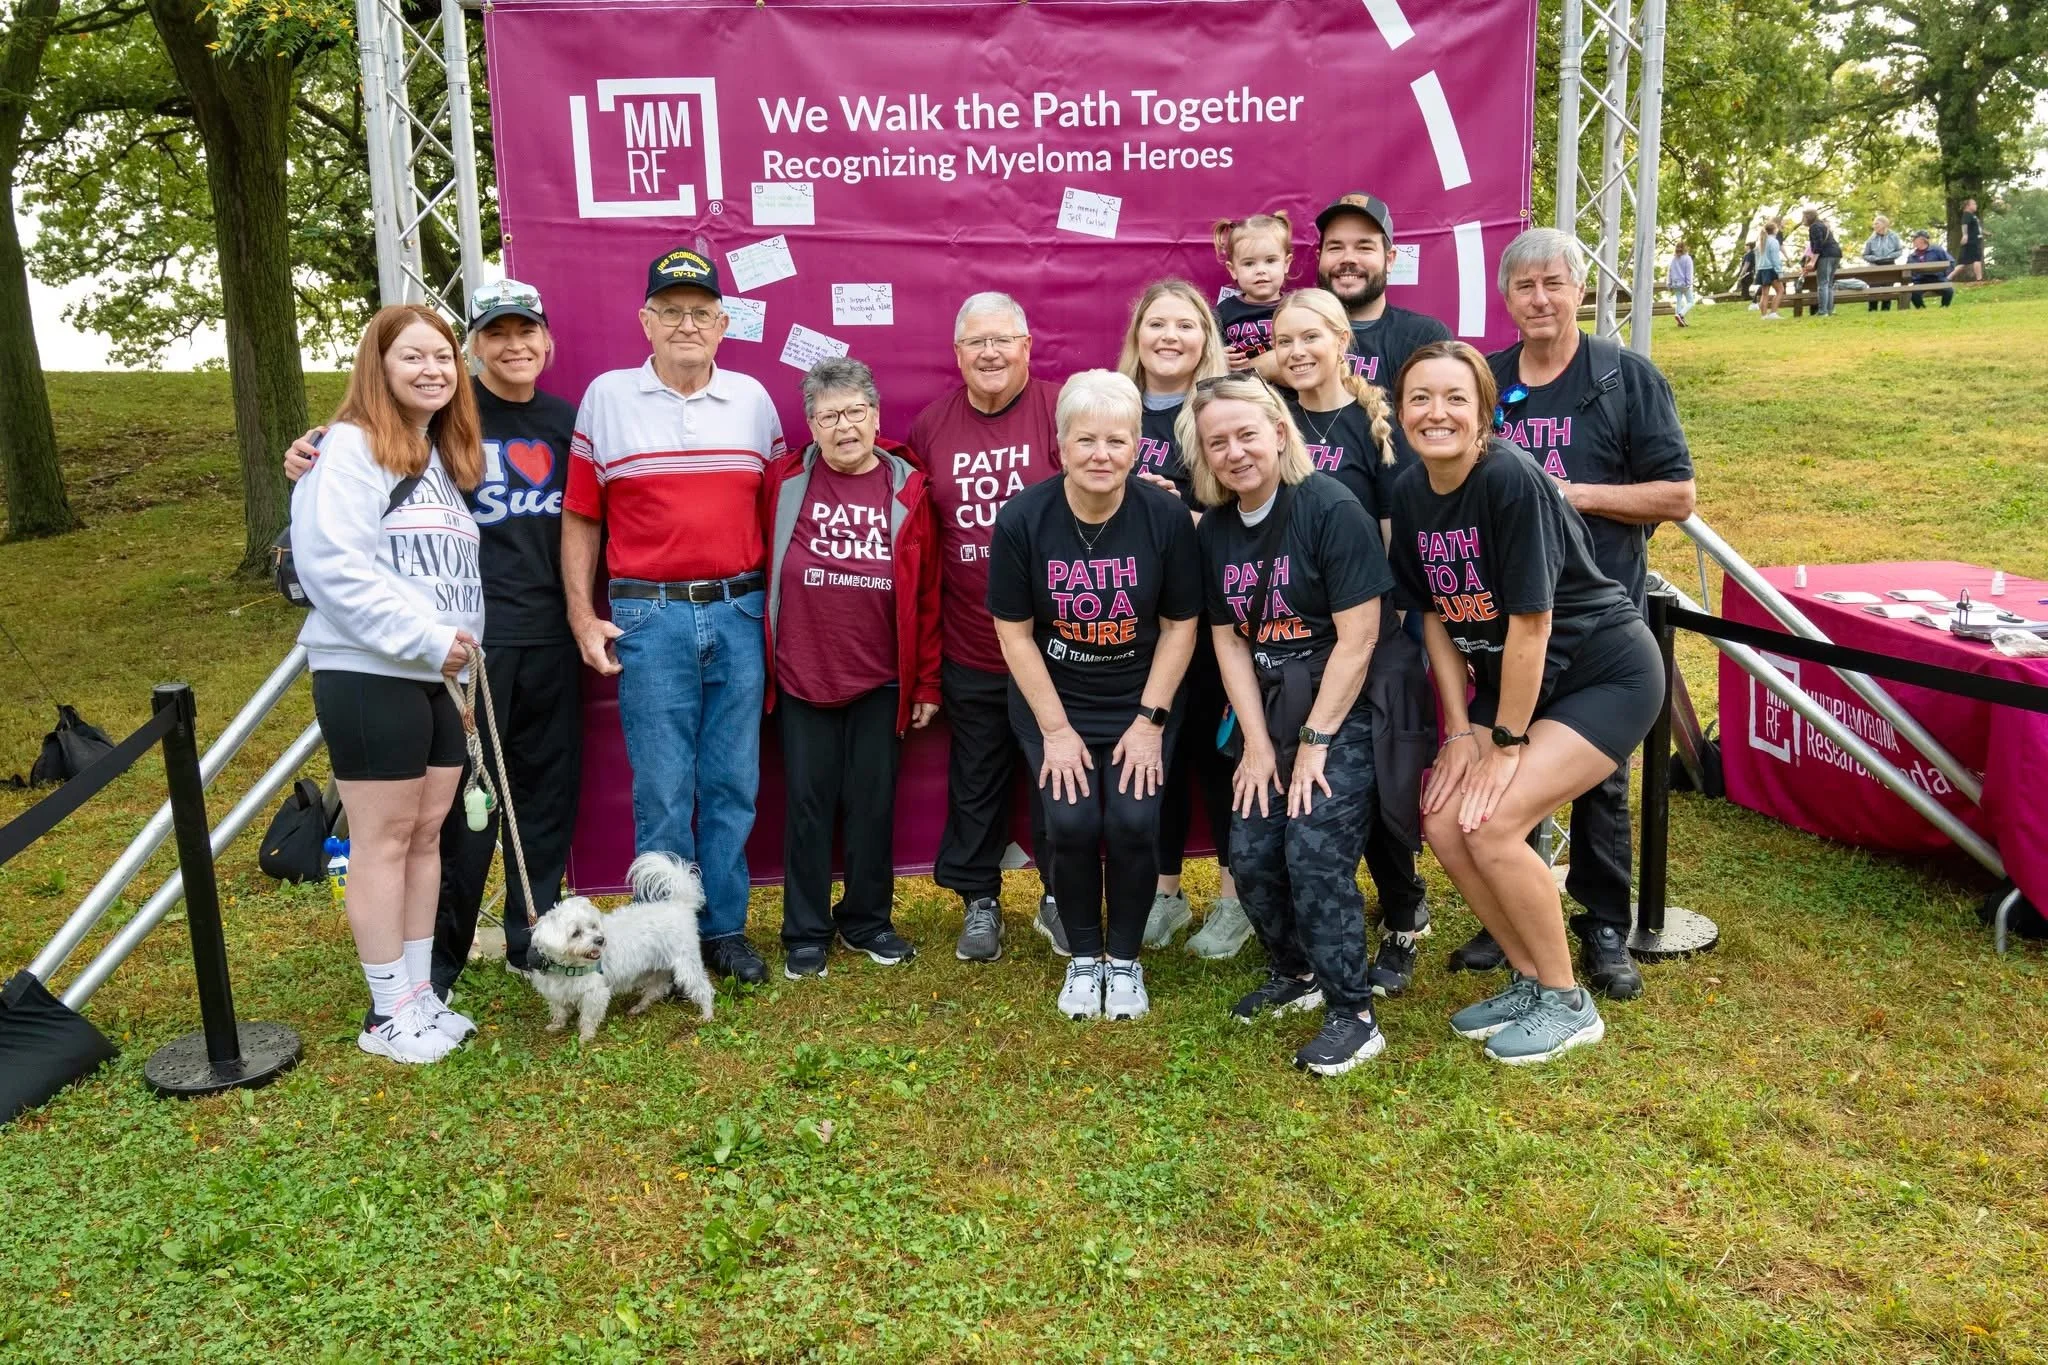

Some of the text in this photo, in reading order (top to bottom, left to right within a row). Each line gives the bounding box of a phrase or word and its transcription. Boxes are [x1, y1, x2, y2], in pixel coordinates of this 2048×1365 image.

[623, 101, 692, 148] MM
[758, 85, 1305, 134] We Walk the Path Together
[627, 149, 667, 194] RF
[763, 141, 1234, 184] Recognizing Myeloma Heroes
[1226, 319, 1273, 344] PAT
[953, 444, 1030, 476] PATH
[1543, 449, 1568, 478] A
[955, 470, 1025, 502] TO A
[471, 484, 562, 525] Sue
[811, 502, 888, 529] PATH
[955, 499, 1009, 529] CU
[810, 537, 892, 561] CURE
[866, 526, 884, 545] A
[979, 545, 991, 558] TE
[1417, 526, 1481, 562] PATH
[1047, 556, 1139, 591] PATH
[1223, 555, 1290, 594] PAH
[1423, 561, 1485, 595] TO A
[435, 583, 481, 613] SPORT
[1051, 589, 1136, 621] TO A
[1272, 589, 1295, 619] A
[1432, 591, 1501, 623] CURE
[1053, 616, 1139, 646] CURE
[1069, 649, 1095, 663] TEAM
[1766, 706, 1782, 741] RF
[1806, 720, 1877, 784] Researc
